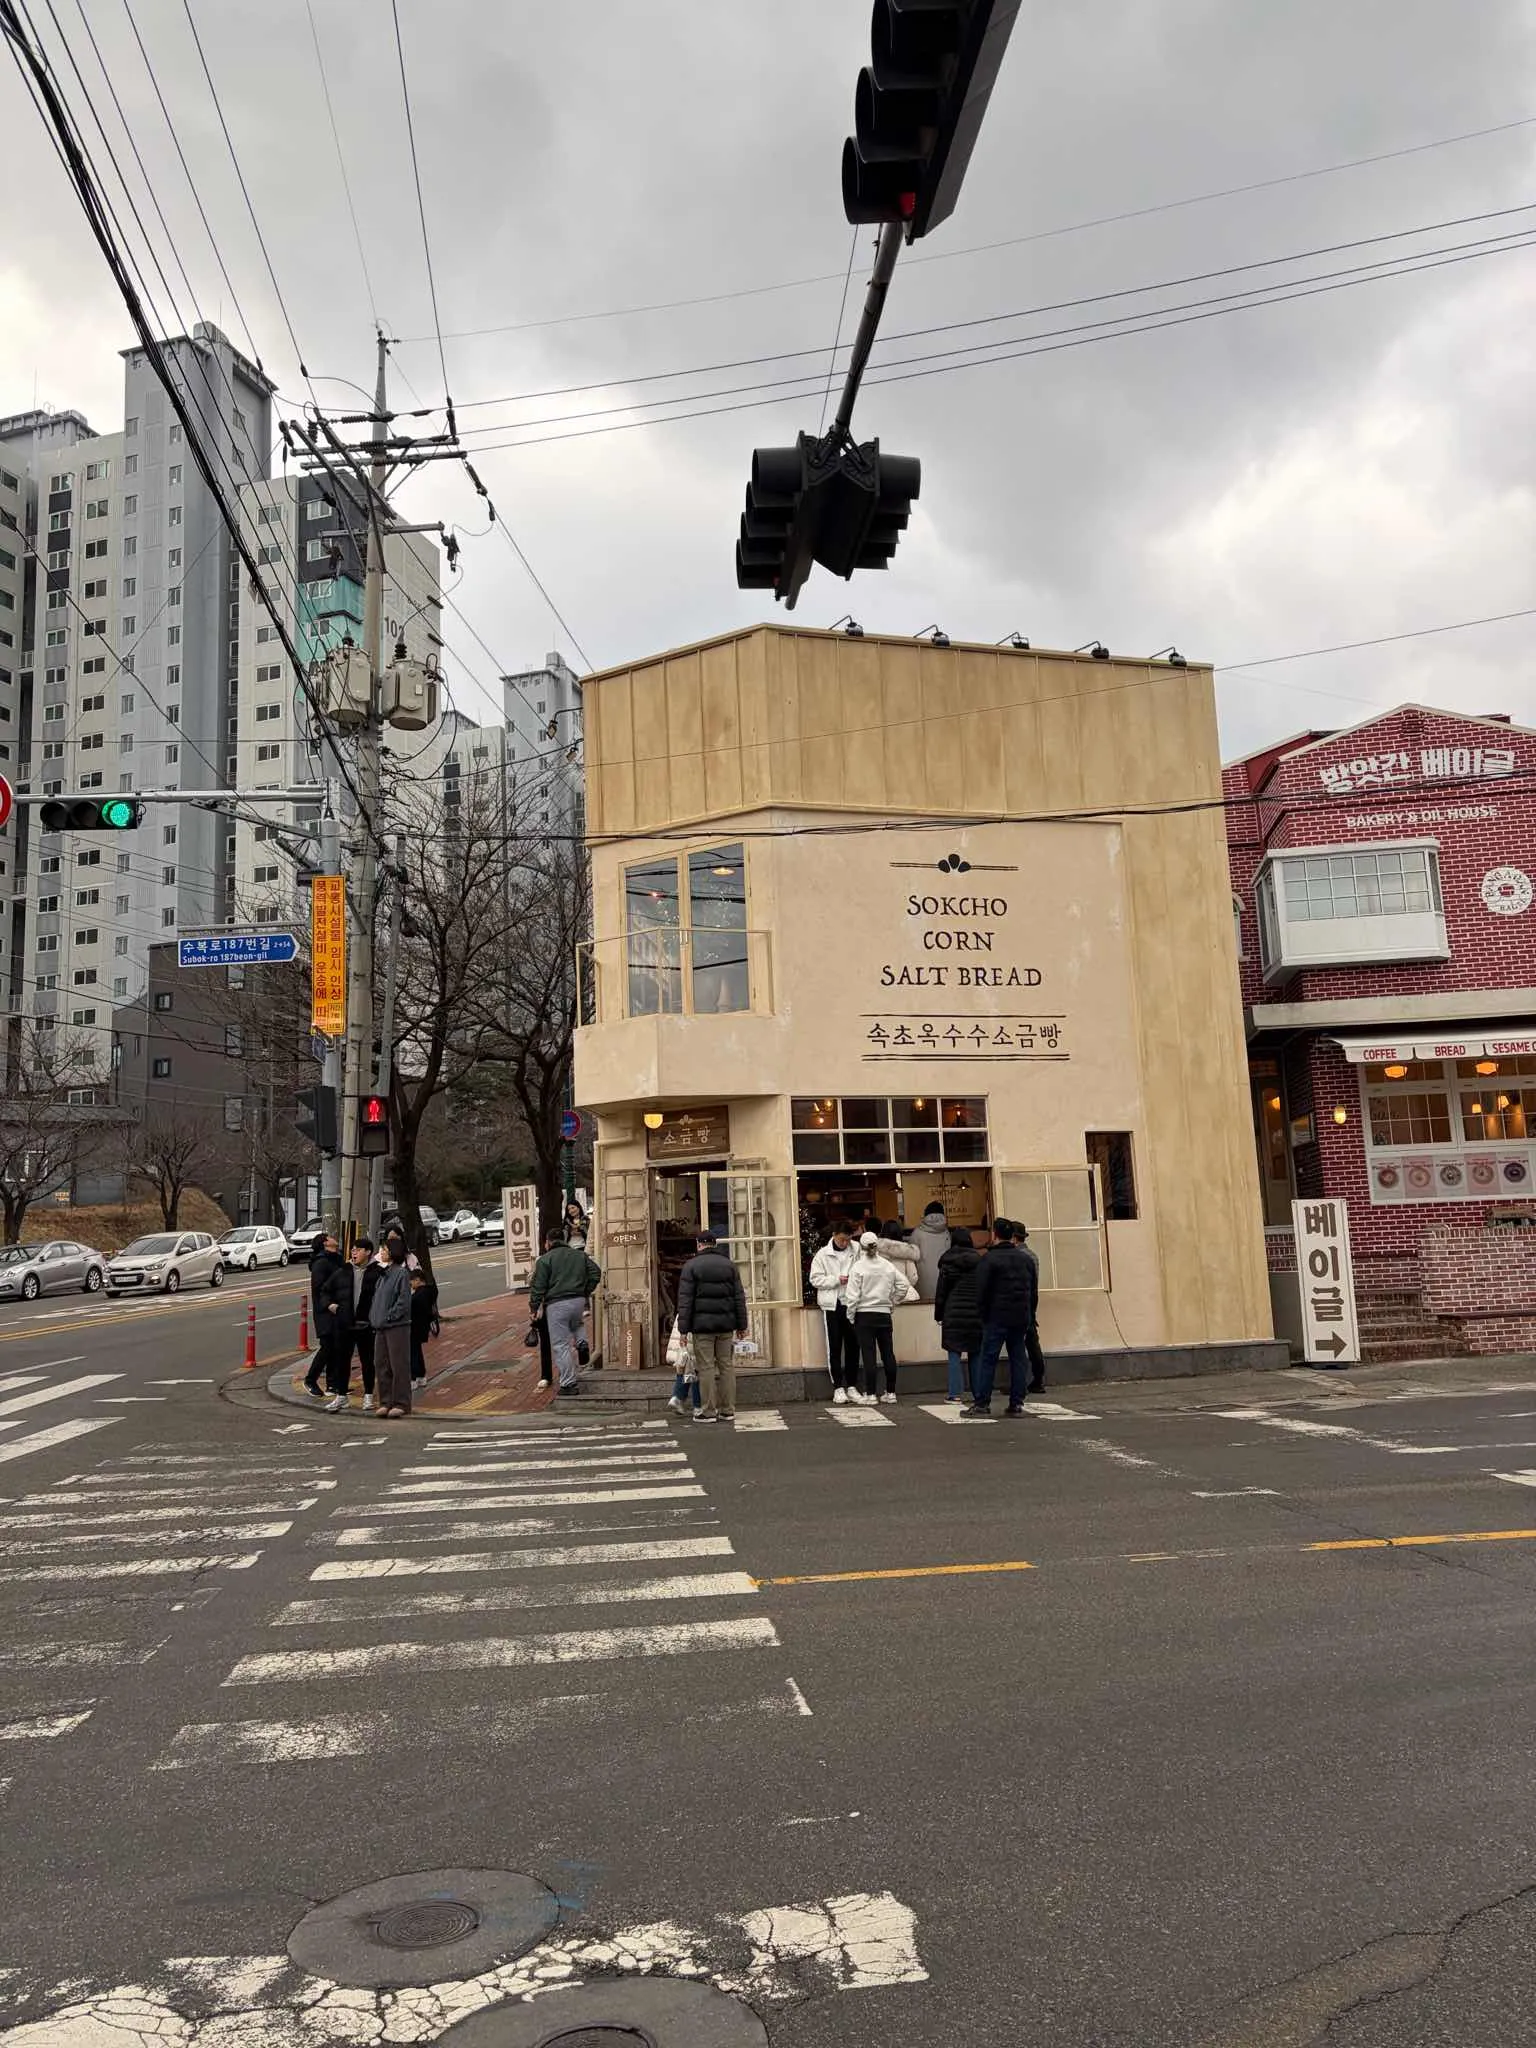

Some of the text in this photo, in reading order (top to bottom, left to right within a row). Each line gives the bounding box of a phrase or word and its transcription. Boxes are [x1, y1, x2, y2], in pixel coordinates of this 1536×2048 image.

[1420, 747, 1516, 777] 베이글
[1421, 810, 1445, 822] OIL
[1447, 805, 1500, 820] HOUSE
[906, 895, 1008, 917] SOKCHO
[183, 936, 271, 955] 수복로187번길
[923, 930, 996, 952] CORN
[183, 950, 268, 964] Subok-ro 187beon-gil
[329, 947, 342, 972] 임시
[315, 961, 328, 1000] 운송에
[880, 965, 1042, 987] SALT BREAD
[329, 974, 342, 1001] 인상
[866, 1022, 1062, 1049] 속초옥수수소금빵
[1363, 1047, 1397, 1060] COFFEE
[1434, 1044, 1467, 1057] BREAD
[1492, 1041, 1532, 1054] SESAME
[663, 1126, 711, 1145] 소금빵
[510, 1188, 533, 1264] 베이글
[613, 1233, 637, 1244] OPEN
[1303, 1202, 1345, 1322] 베이글
